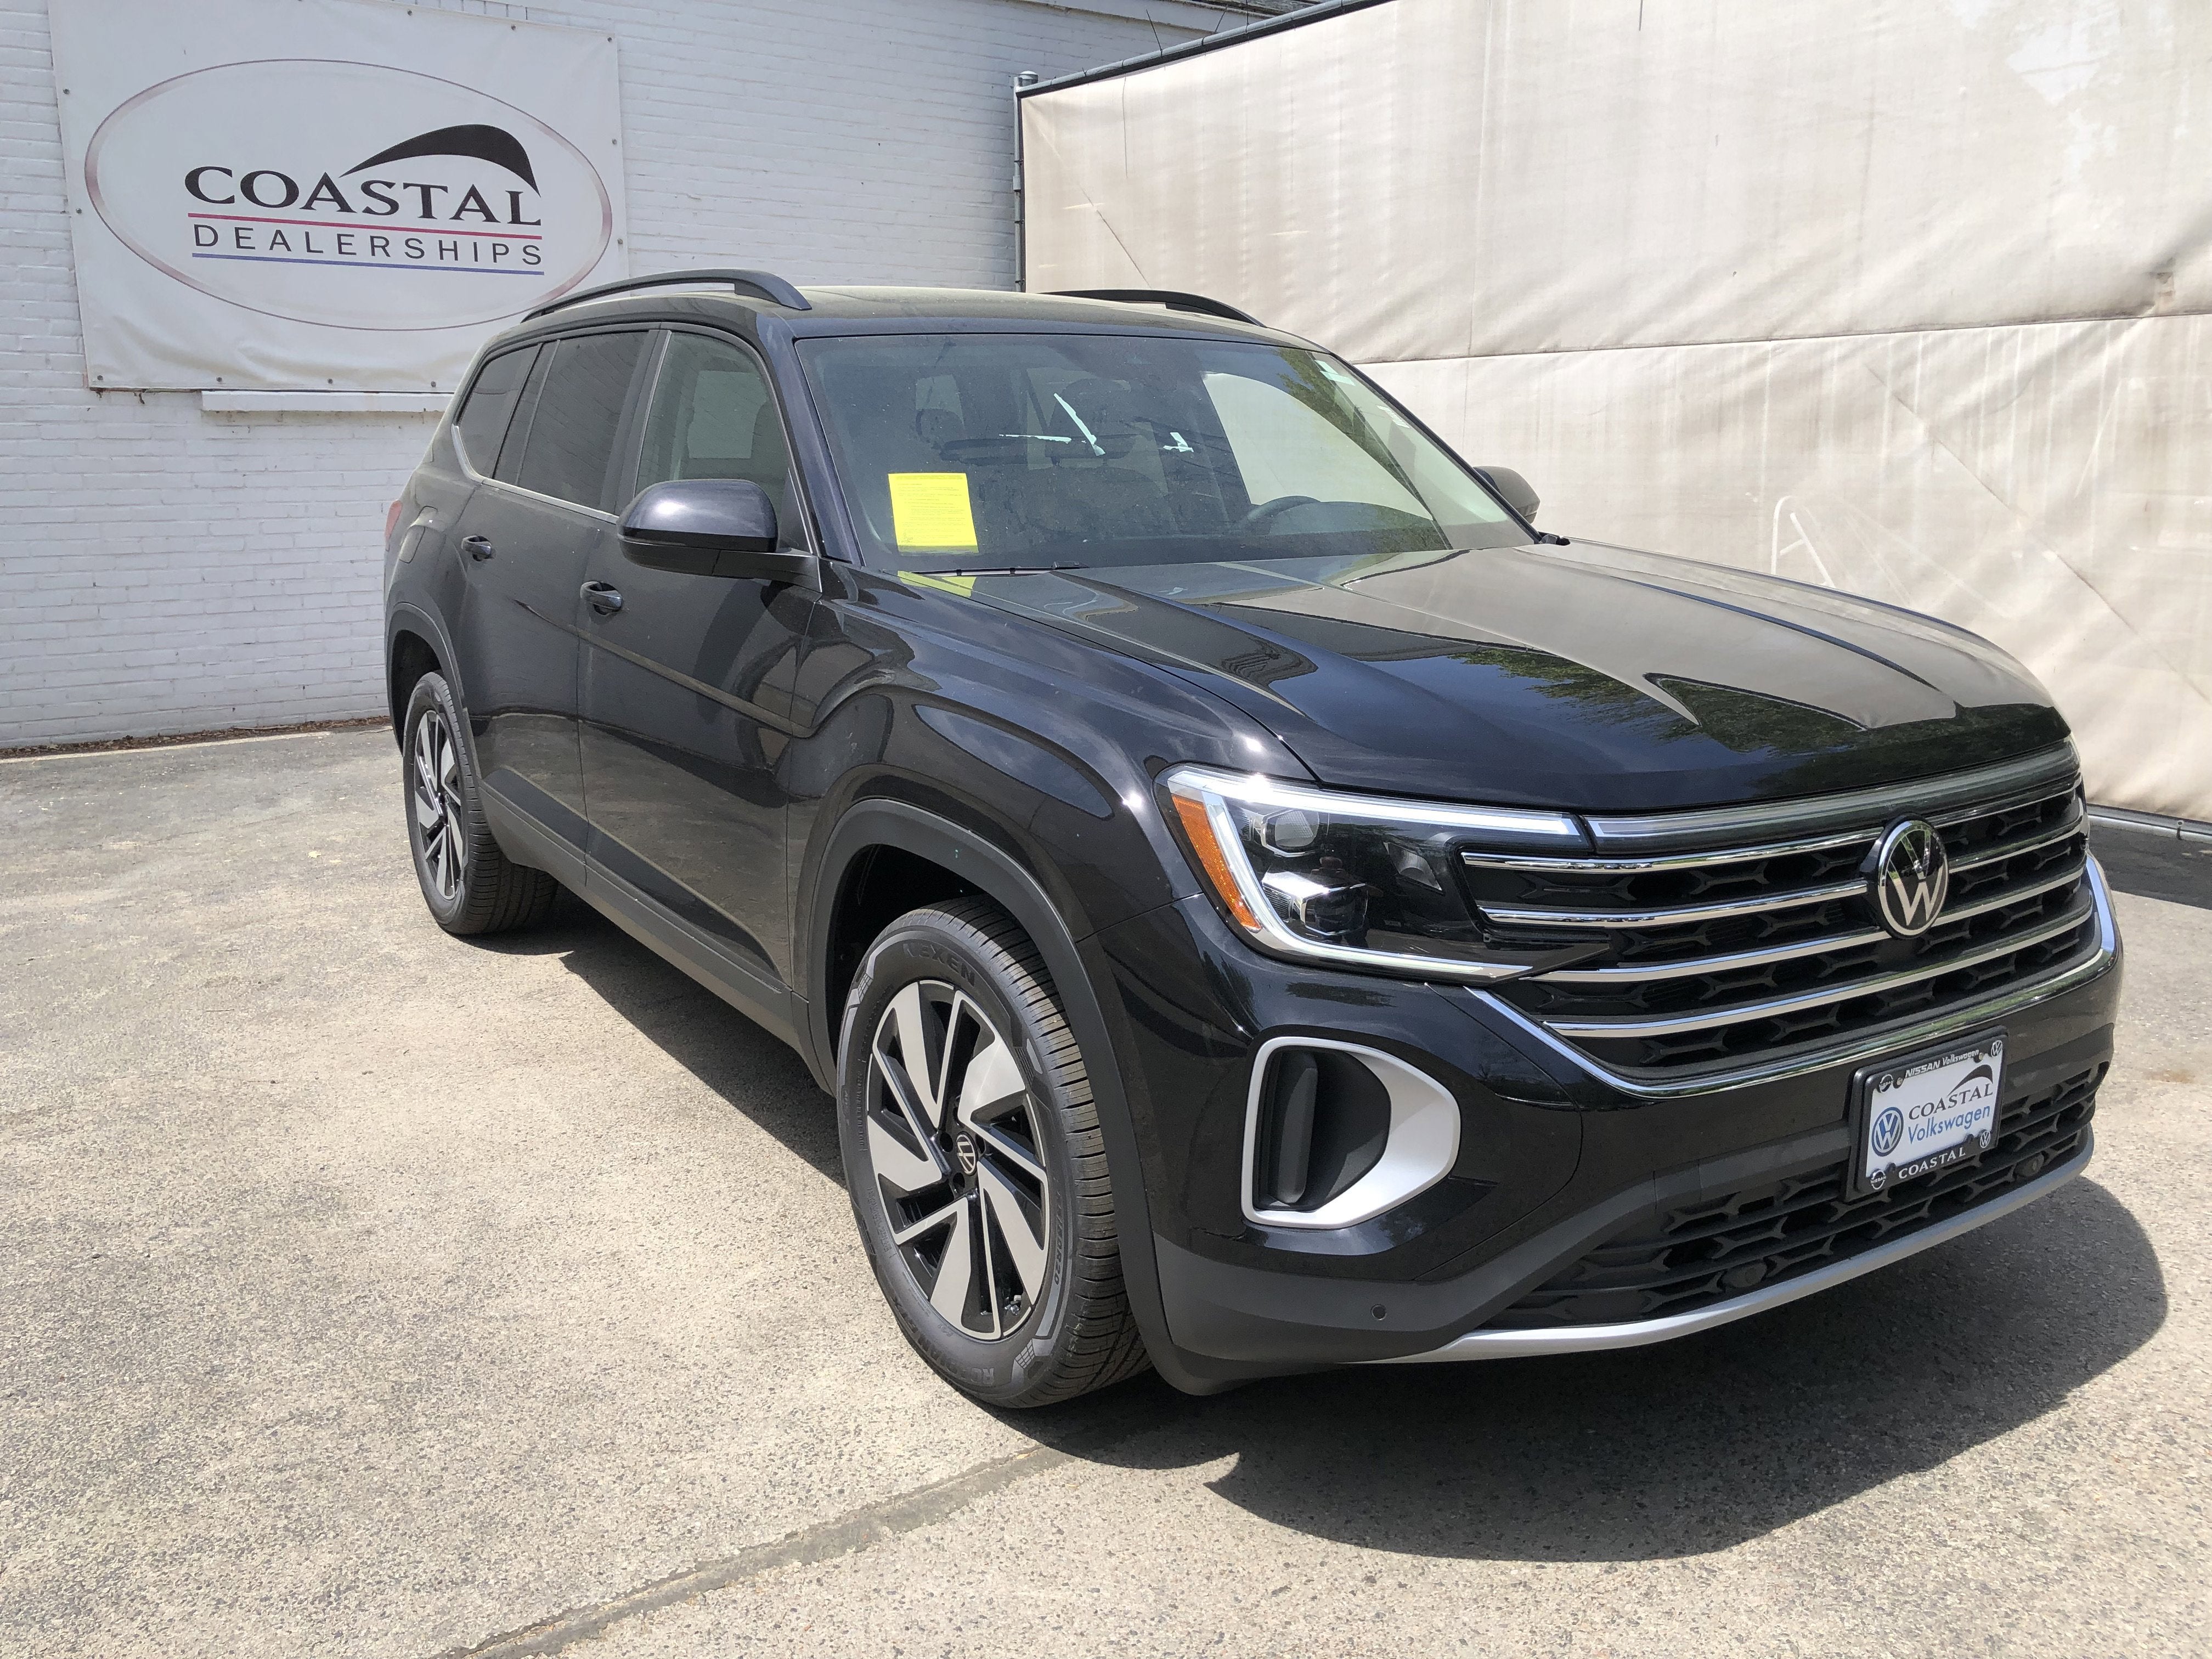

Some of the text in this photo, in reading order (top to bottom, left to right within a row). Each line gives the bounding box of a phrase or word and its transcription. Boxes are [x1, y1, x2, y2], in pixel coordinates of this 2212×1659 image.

[184, 166, 541, 226] COASTAL
[194, 224, 542, 266] DEALERSHIPS
[903, 943, 975, 987] NEXEN
[1905, 1049, 1979, 1078] NISSAN Volkswagen
[1909, 1084, 1993, 1120] COASTAL
[1908, 1105, 1990, 1144] Volkswagen
[1898, 1147, 1966, 1179] COASTAL
